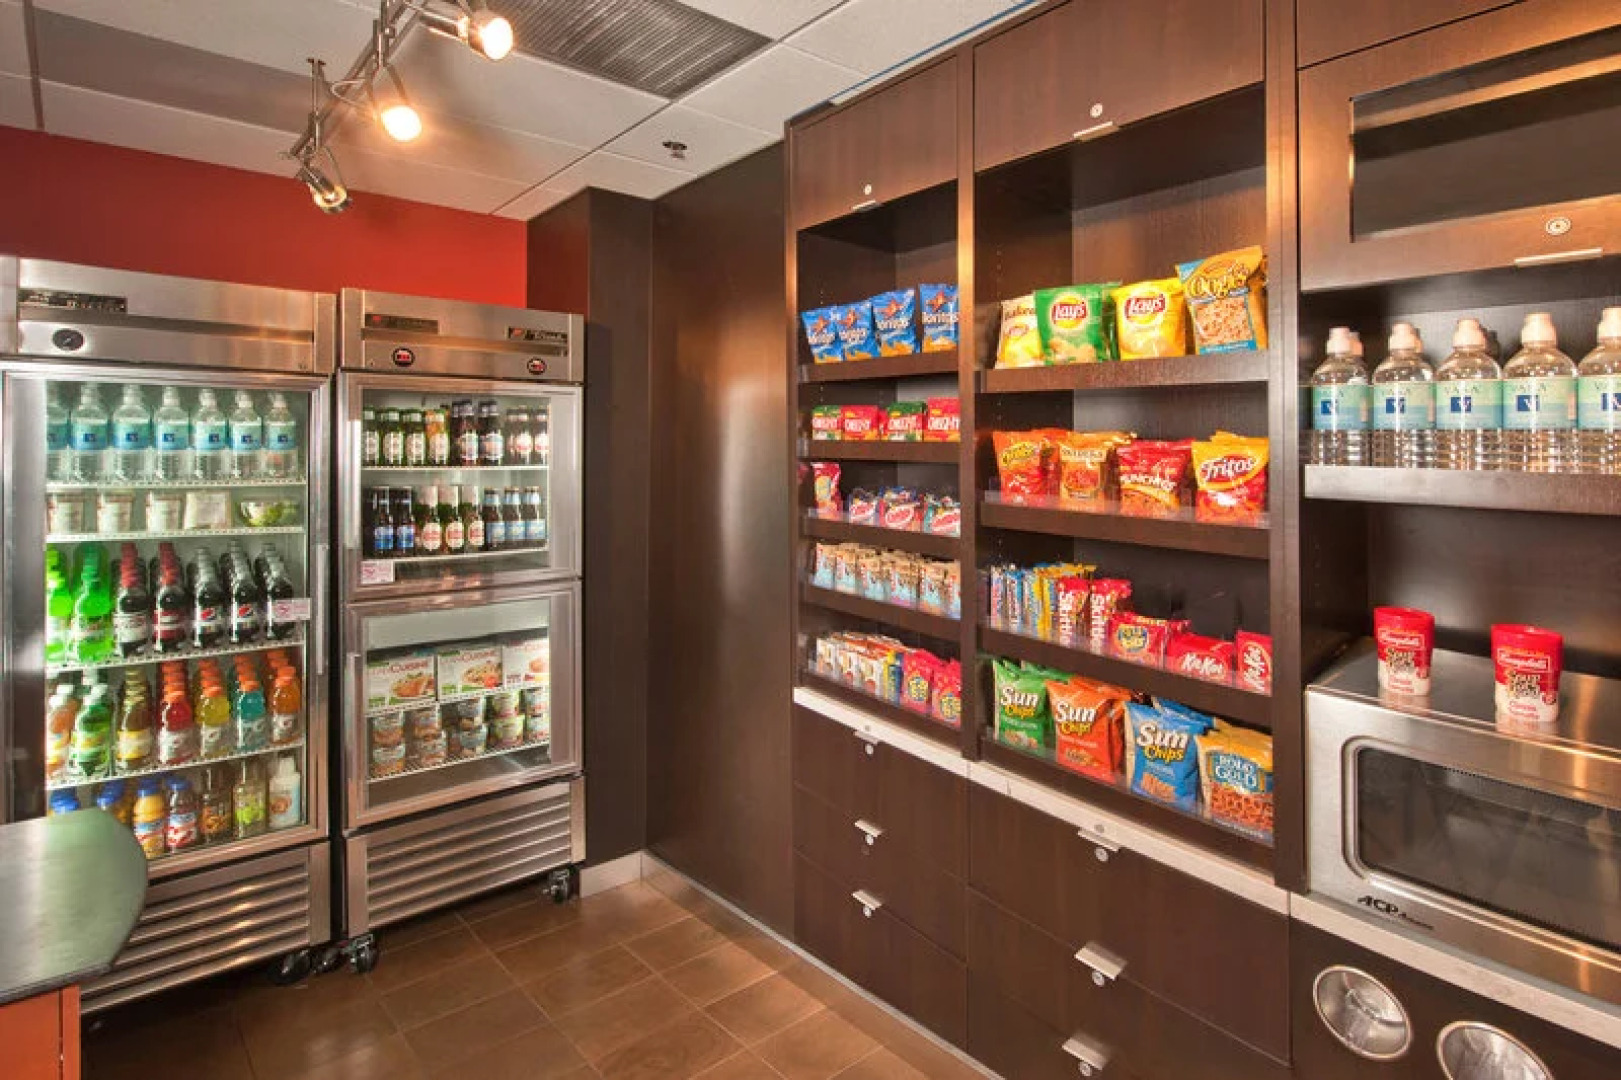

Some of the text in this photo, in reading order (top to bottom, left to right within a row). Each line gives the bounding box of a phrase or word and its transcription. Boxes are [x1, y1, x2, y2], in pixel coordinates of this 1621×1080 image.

[1000, 686, 1039, 707] Sun
[1055, 701, 1097, 723] Sun
[1136, 723, 1189, 749] Sun
[1143, 745, 1185, 763] Chips
